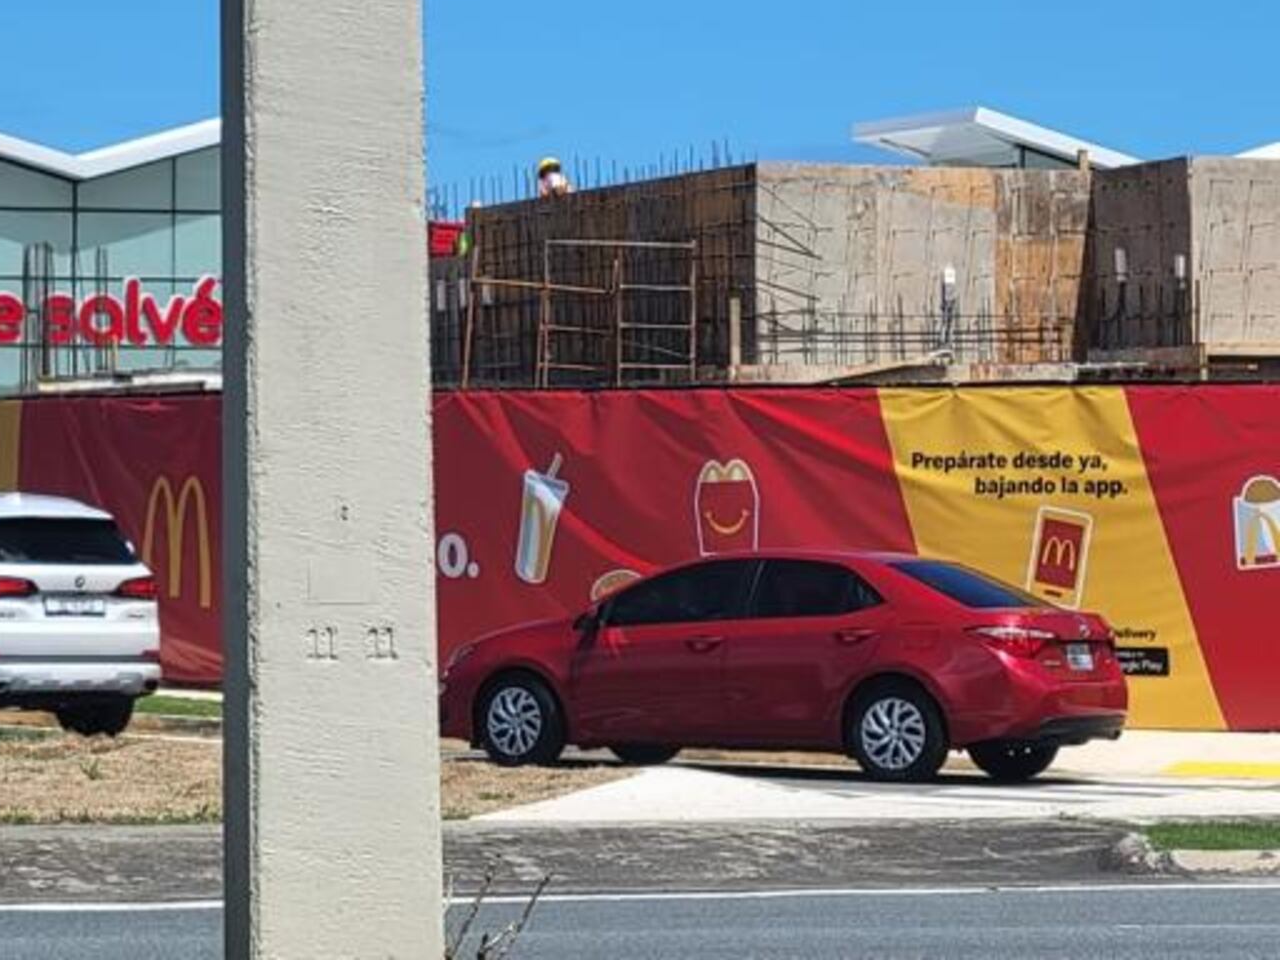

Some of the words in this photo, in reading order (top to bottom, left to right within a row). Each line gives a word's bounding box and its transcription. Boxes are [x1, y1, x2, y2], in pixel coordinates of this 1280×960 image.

[44, 275, 223, 347] salvé
[911, 451, 1008, 473] Prepárate
[1012, 452, 1073, 469] desde
[1078, 455, 1108, 473] ya,
[974, 477, 1056, 498] bajando
[1061, 477, 1078, 493] la
[1084, 482, 1128, 498] app.
